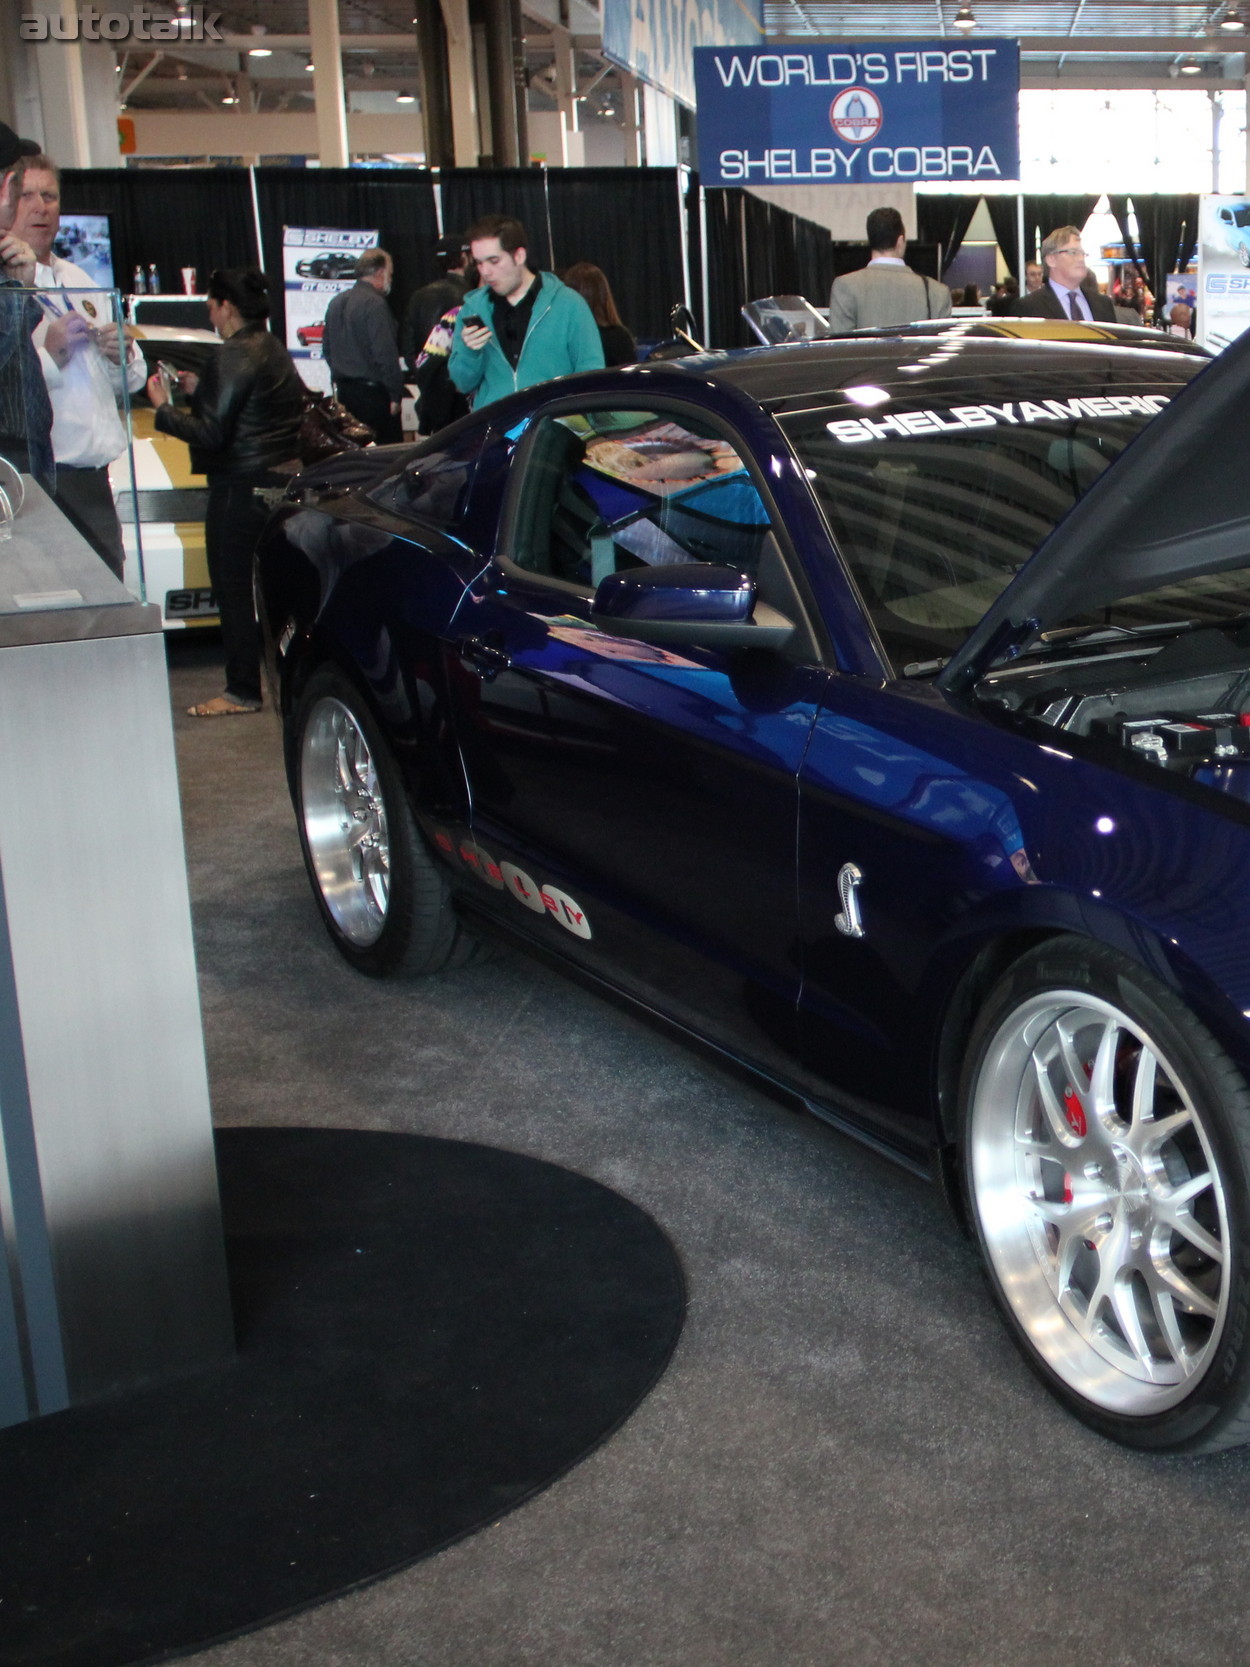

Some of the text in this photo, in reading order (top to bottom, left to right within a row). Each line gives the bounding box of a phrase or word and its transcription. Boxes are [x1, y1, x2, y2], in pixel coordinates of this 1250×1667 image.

[714, 49, 997, 88] WORLD'S FIRST
[834, 117, 878, 127] COBRA
[719, 145, 1001, 179] SHELBY COBRA
[304, 230, 372, 246] SHELBY
